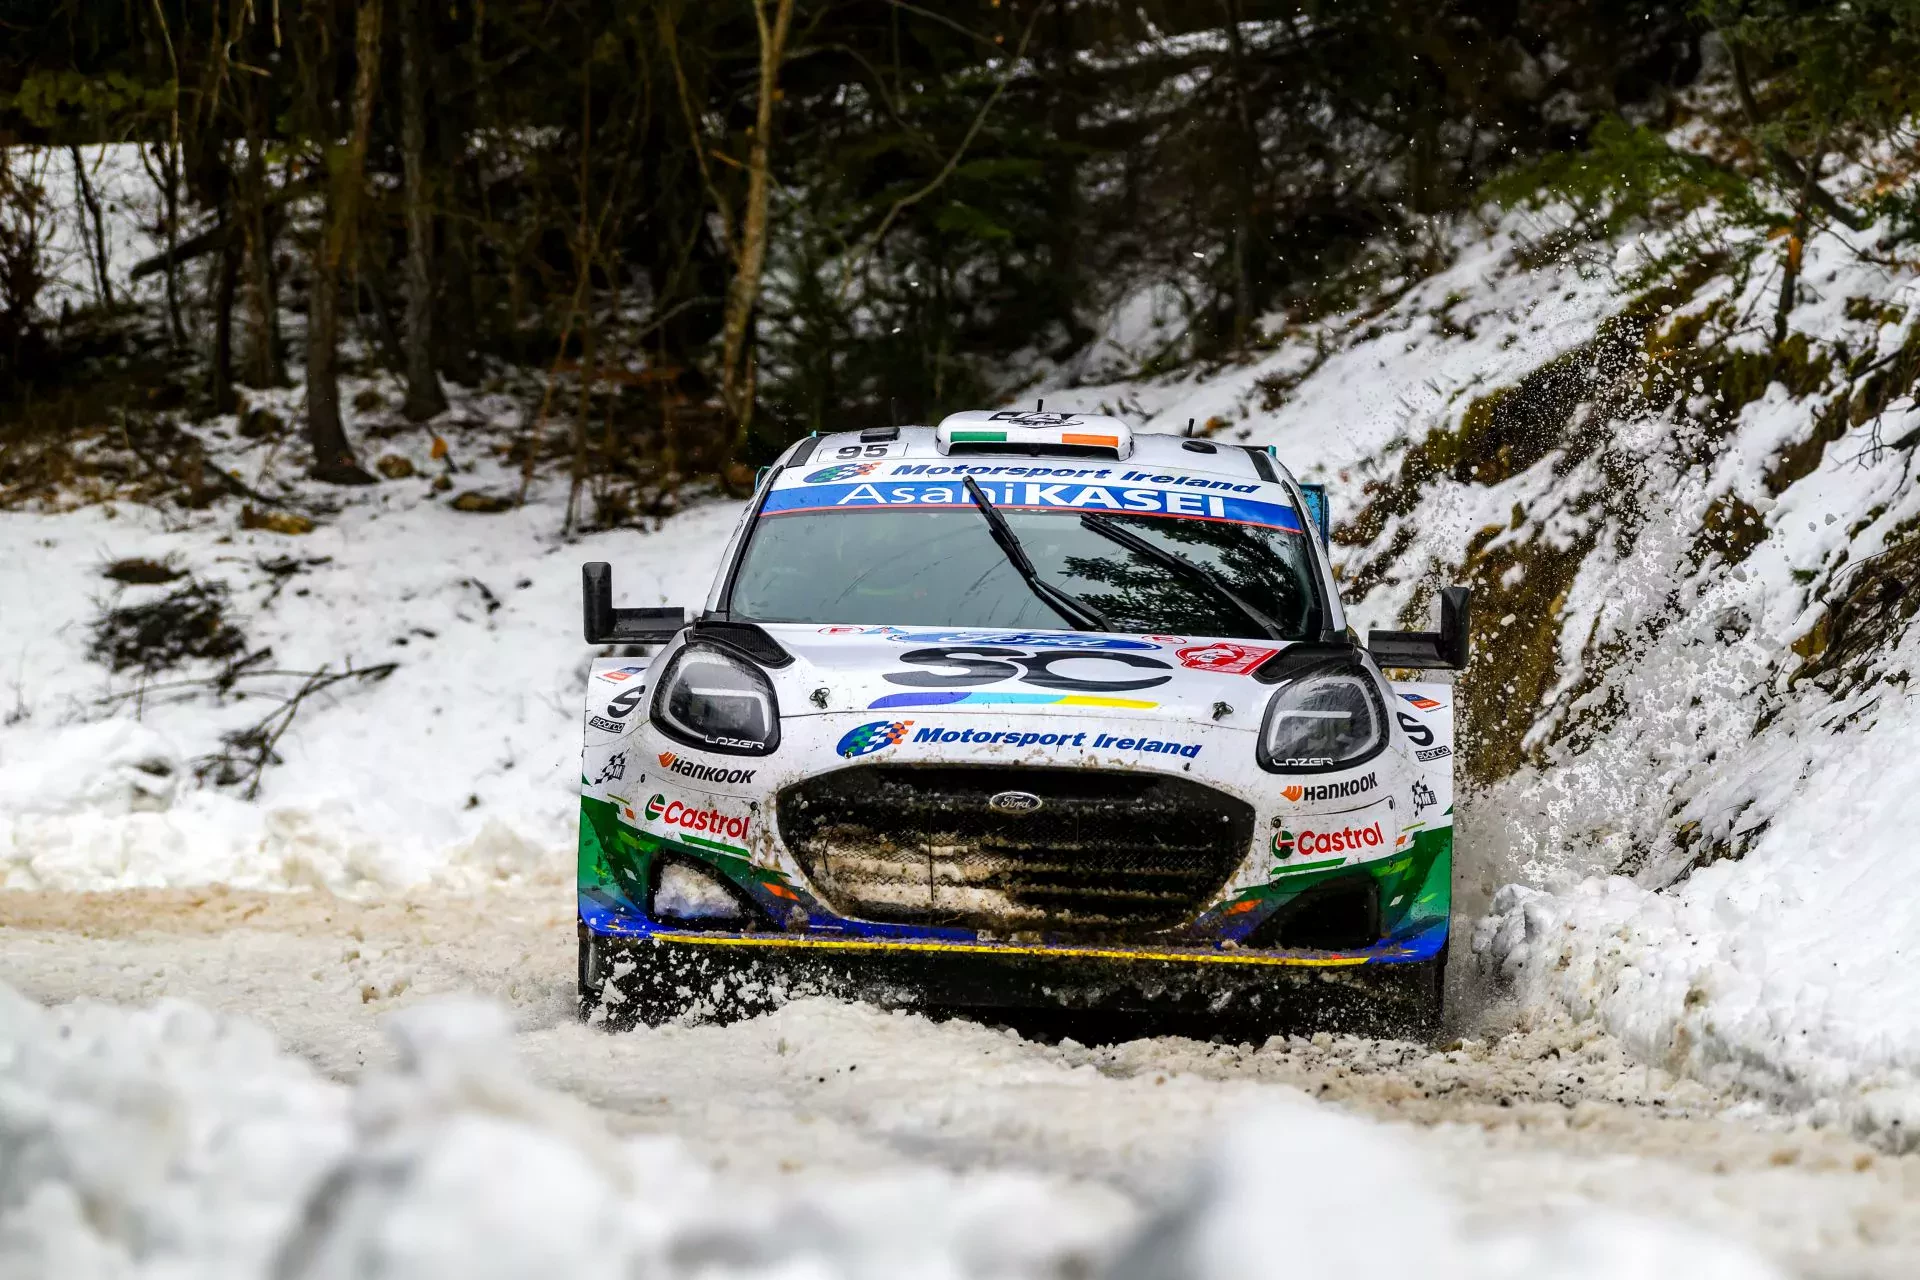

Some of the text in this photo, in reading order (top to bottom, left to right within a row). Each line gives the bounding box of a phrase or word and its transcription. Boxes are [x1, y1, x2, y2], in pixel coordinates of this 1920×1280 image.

[836, 444, 889, 460] 95
[891, 464, 1261, 494] Motorsport Ireland
[882, 647, 1174, 692] SC
[607, 685, 646, 718] S
[591, 717, 624, 731] sparco
[1396, 712, 1434, 746] S
[705, 735, 765, 750] LAZER
[913, 727, 1202, 759] Motorsport Ireland
[1416, 746, 1449, 760] sparco
[1272, 757, 1334, 766] LAZER
[1000, 795, 1031, 809] Ford
[664, 801, 750, 840] Castrol
[1298, 821, 1384, 855] Castrol
